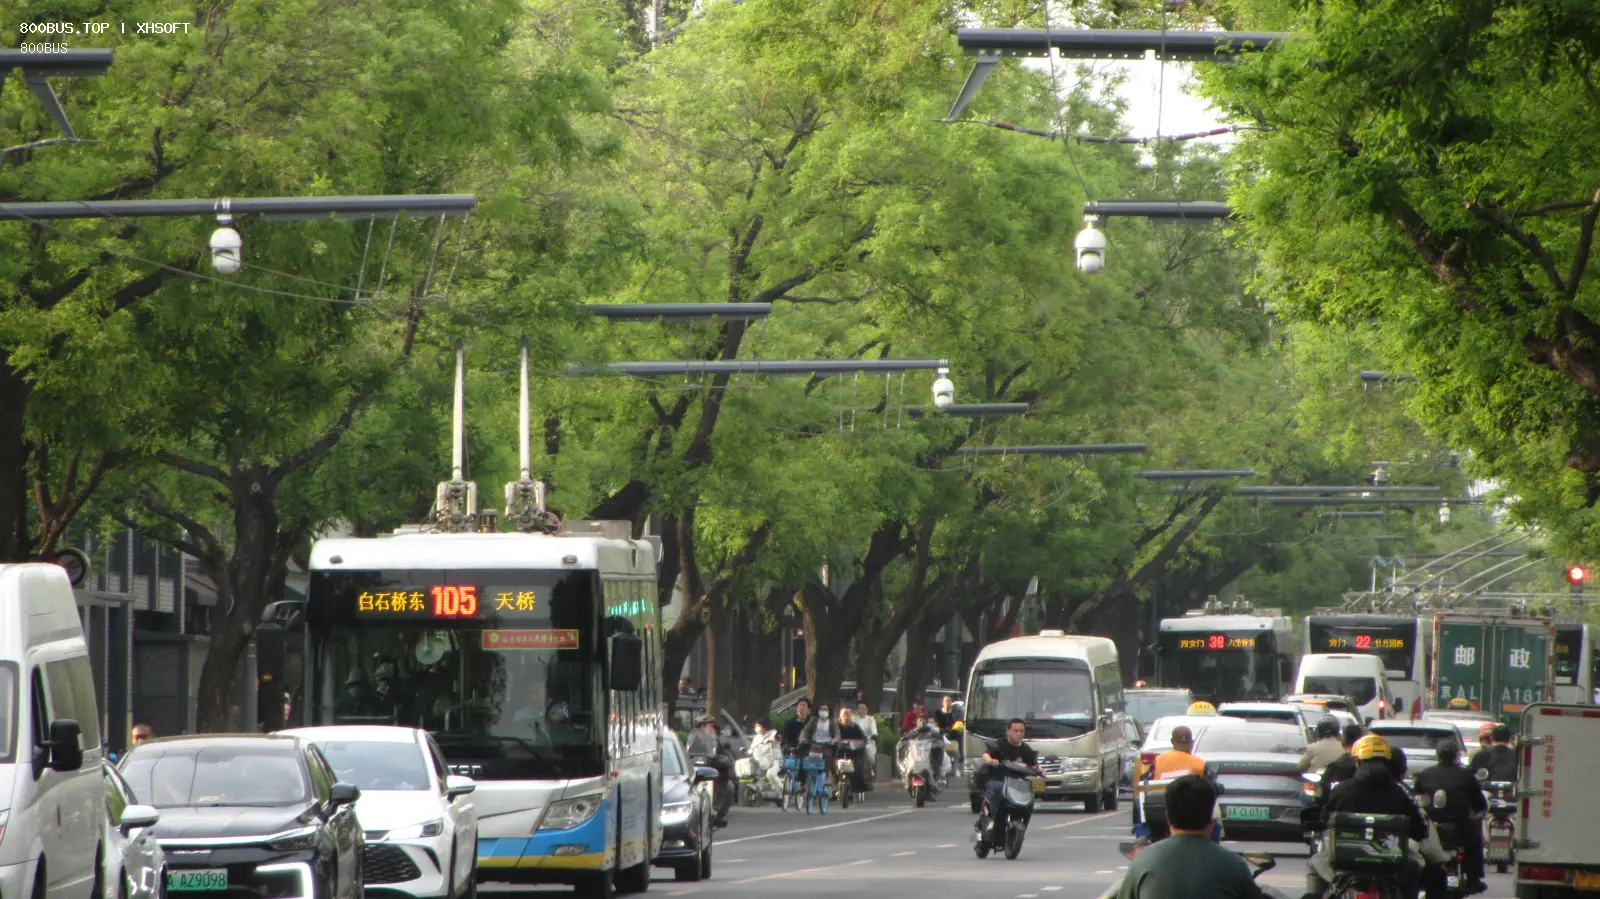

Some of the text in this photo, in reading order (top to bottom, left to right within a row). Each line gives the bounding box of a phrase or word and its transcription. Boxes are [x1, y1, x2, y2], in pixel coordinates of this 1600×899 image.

[358, 585, 536, 616] 白石桥东 105 天桥
[1208, 635, 1225, 649] 38
[1355, 635, 1371, 649] 22
[1544, 734, 1556, 774] 环卫作业
[180, 872, 226, 888] AZ9098
